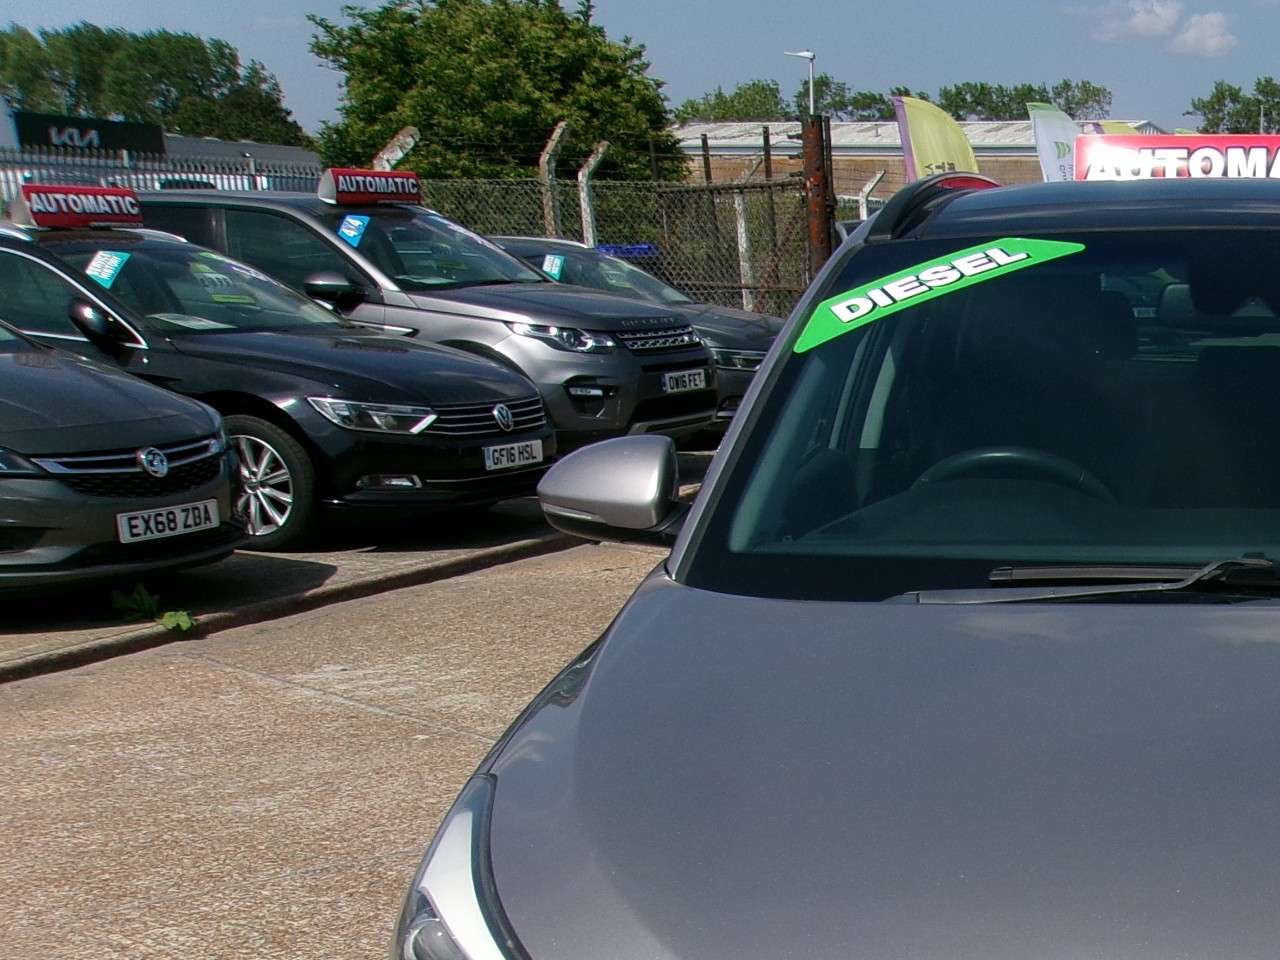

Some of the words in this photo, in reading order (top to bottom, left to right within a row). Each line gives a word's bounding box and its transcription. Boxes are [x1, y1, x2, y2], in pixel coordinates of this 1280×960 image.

[337, 175, 419, 194] AUTOMATIC
[30, 192, 140, 215] AUTOMATIC
[830, 247, 1031, 323] DIESEL
[492, 447, 516, 465] GF16
[518, 443, 537, 461] HSL
[127, 510, 178, 538] EX68
[181, 504, 213, 529] ZBA
